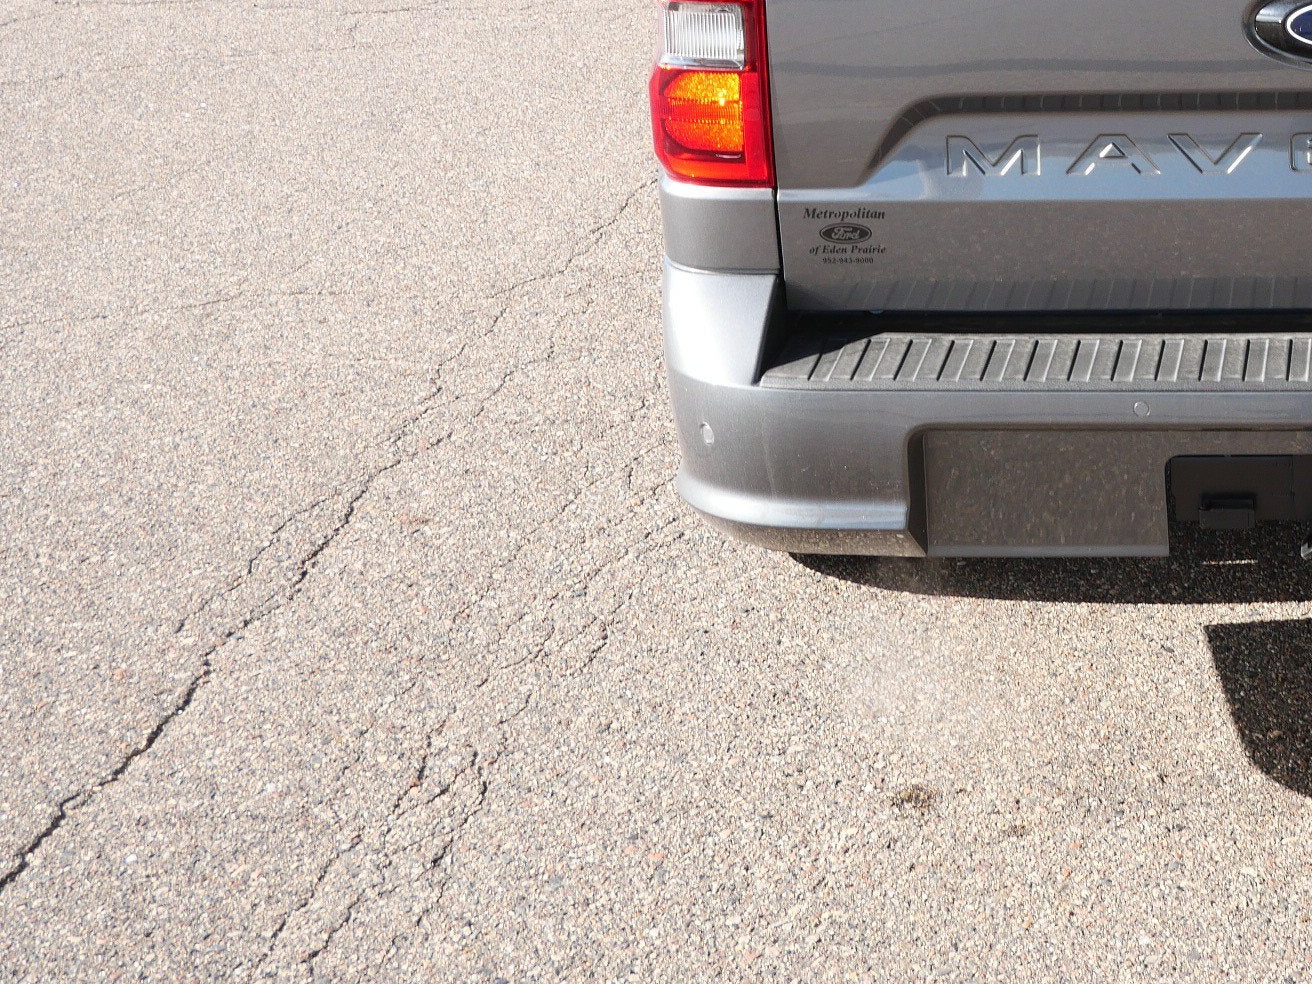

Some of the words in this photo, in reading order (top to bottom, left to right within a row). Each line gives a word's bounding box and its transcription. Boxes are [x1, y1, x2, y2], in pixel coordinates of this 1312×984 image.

[803, 206, 886, 222] Metropolitan
[831, 226, 860, 240] Ford
[809, 245, 821, 255] of
[822, 244, 848, 254] Eden
[851, 244, 886, 254] Prairie
